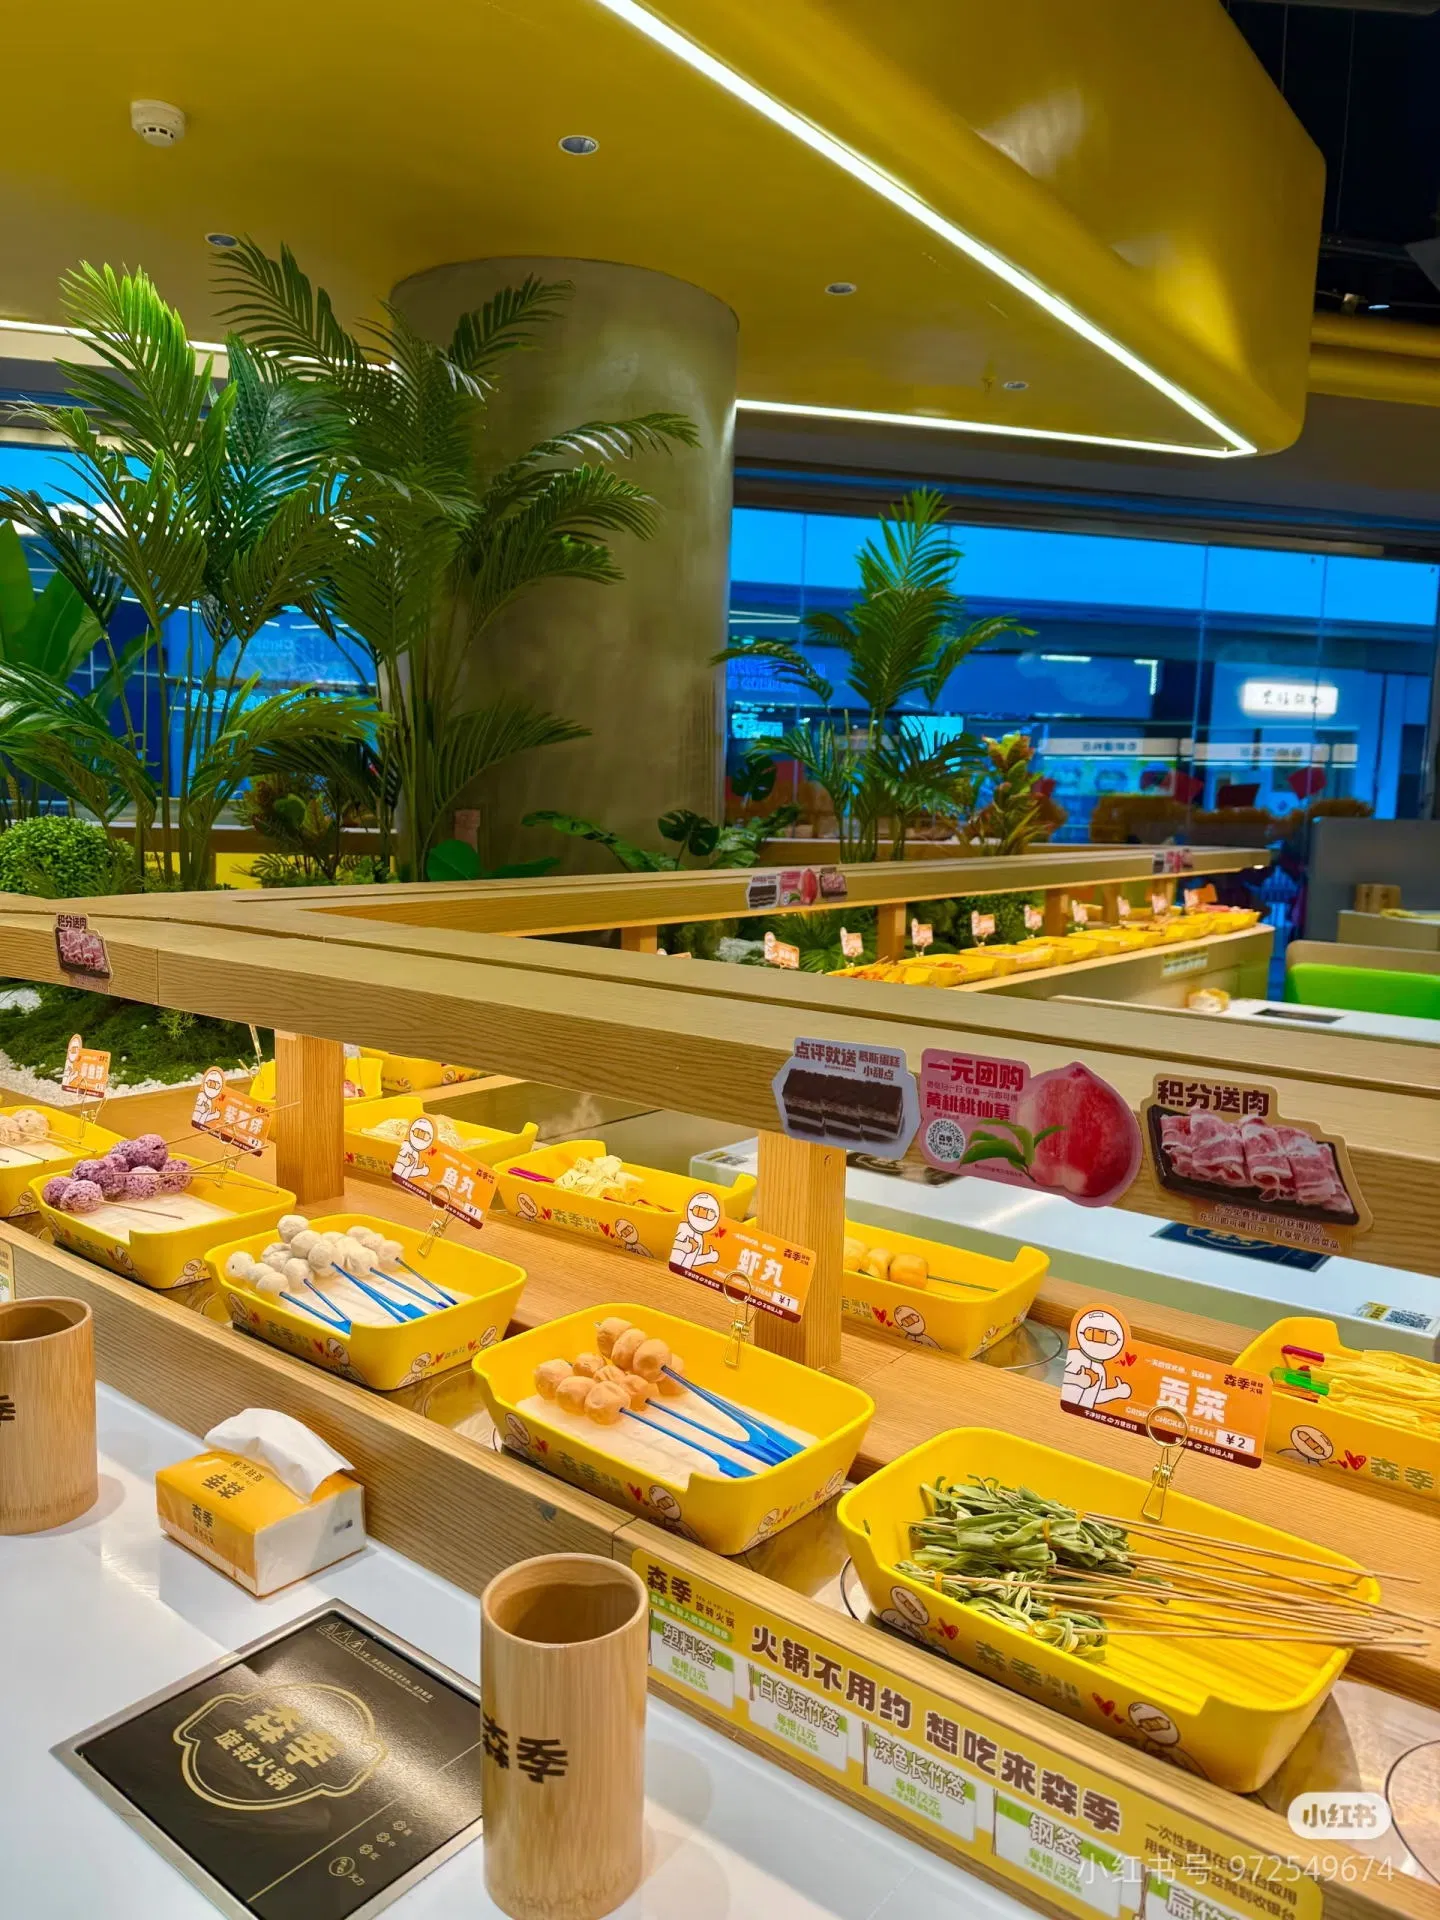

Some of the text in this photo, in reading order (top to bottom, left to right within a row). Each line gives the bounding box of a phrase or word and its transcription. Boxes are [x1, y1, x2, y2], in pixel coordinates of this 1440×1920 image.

[795, 1042, 857, 1068] 点评就送
[863, 1066, 894, 1081] 小甜点
[927, 1058, 1024, 1092] 一元团购
[1157, 1079, 1270, 1117] 积分送肉
[440, 1166, 475, 1200] 鱼丸
[553, 1208, 583, 1229] 森季
[736, 1247, 784, 1288] 虾丸
[1156, 1376, 1228, 1424] 贡菜
[1224, 1373, 1251, 1391] 森季
[1125, 1406, 1149, 1419] CRISP
[1226, 1433, 1246, 1449] ¥2
[1370, 1455, 1434, 1491] 森季
[648, 1564, 692, 1605] 森季
[662, 1622, 716, 1671] 塑料签
[975, 1639, 1043, 1688] 森季
[759, 1673, 840, 1738] 白色短竹签
[244, 1703, 345, 1768] 森季
[482, 1711, 568, 1784] 森季
[752, 1626, 1120, 1834] 火锅不用约 想吃来森季
[213, 1729, 298, 1791] 旋转火锅
[873, 1732, 966, 1806] 深色长竹签
[1029, 1812, 1082, 1864] 钢签
[1166, 1884, 1246, 1920] 扁竹
